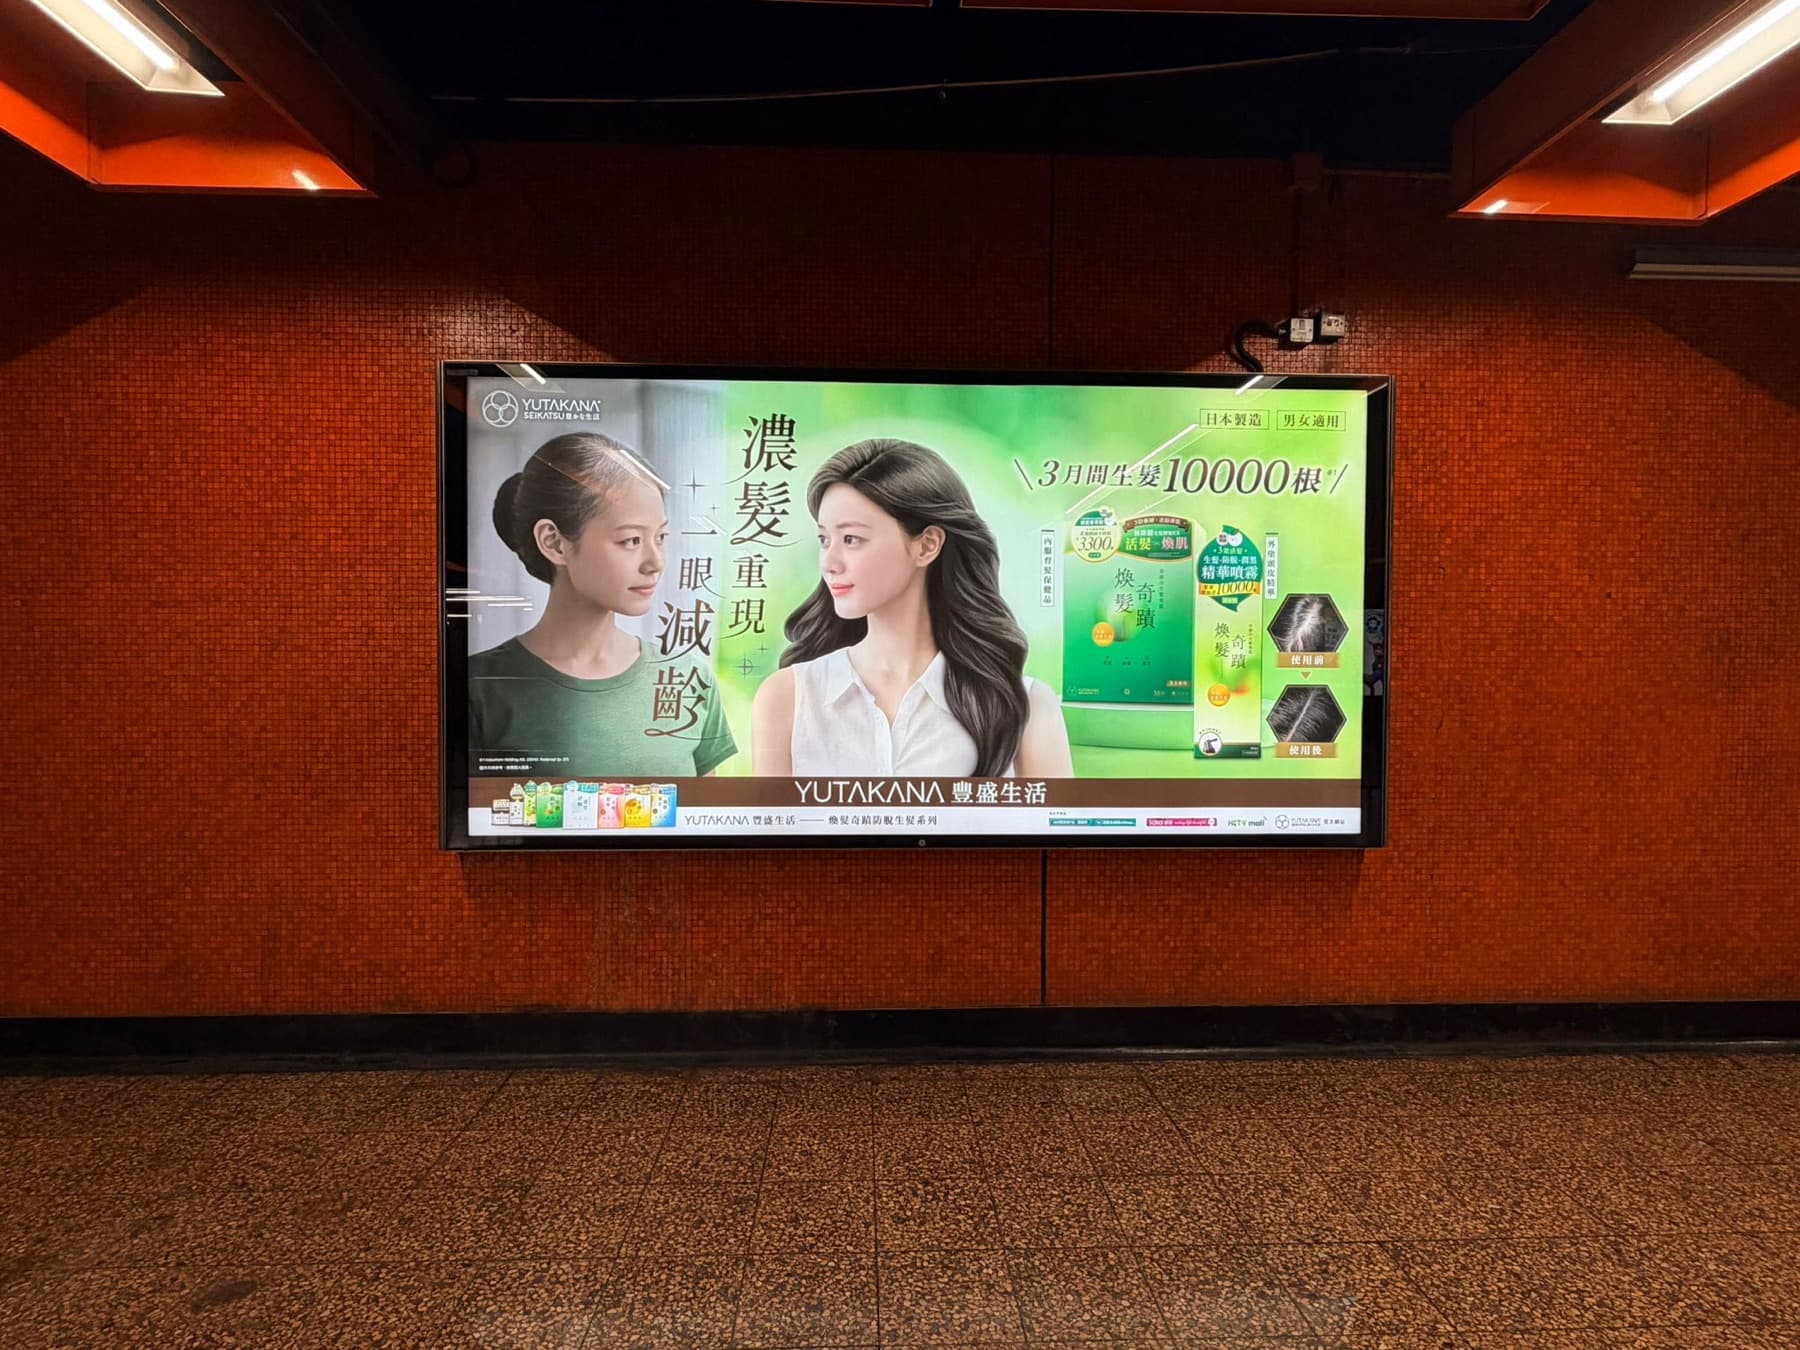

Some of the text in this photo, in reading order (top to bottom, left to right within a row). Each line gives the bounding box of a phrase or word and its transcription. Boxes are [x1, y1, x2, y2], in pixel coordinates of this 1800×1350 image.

[522, 398, 601, 412] YUTAKANA
[523, 412, 564, 420] SEIKATSU
[1206, 412, 1262, 427] 日本製造
[1283, 413, 1339, 428] 男女適用
[724, 413, 799, 638] 濃髮重現
[646, 528, 724, 739] 一眼減齡
[1291, 655, 1325, 665] 使用前
[1289, 745, 1323, 755] 使用後
[795, 781, 1048, 804] YUTAKANA 豐盛生活
[685, 815, 750, 825] YUTAKANA
[752, 815, 796, 825] 豐盛生活
